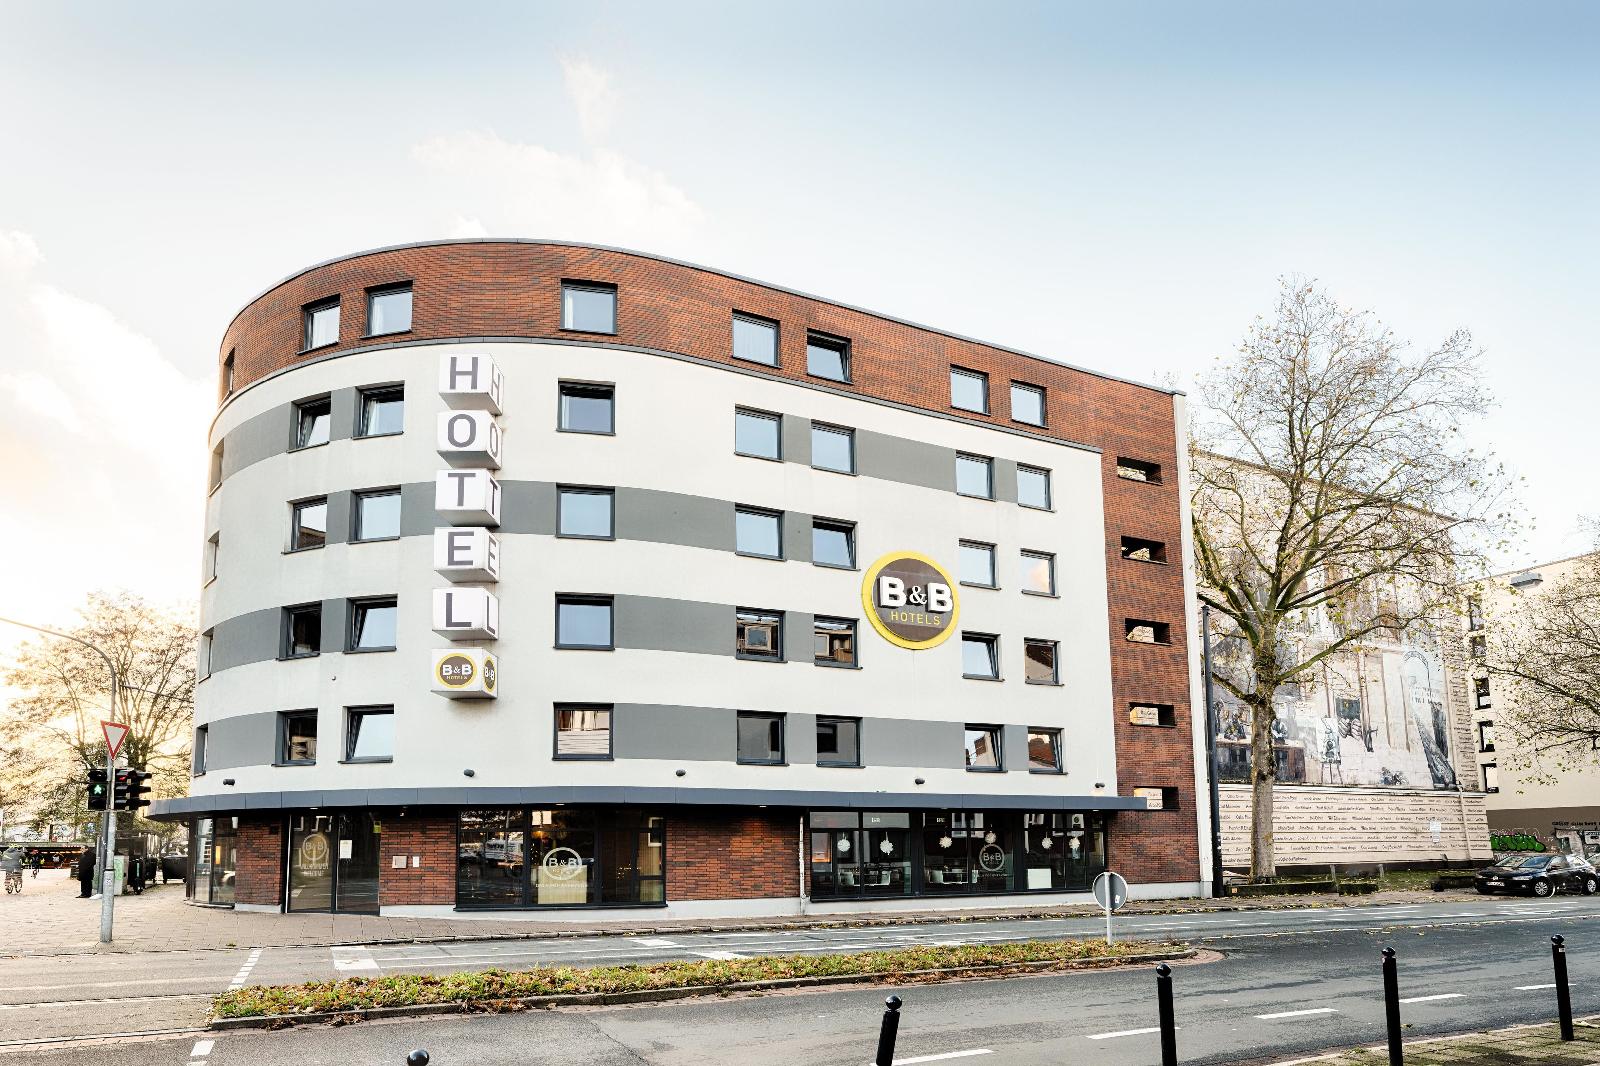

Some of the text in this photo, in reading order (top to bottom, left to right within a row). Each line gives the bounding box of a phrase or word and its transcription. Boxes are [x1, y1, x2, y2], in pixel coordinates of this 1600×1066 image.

[446, 357, 478, 628] HOTEL
[879, 575, 953, 612] B&B
[890, 611, 941, 625] HOTELS
[442, 664, 472, 675] B&B
